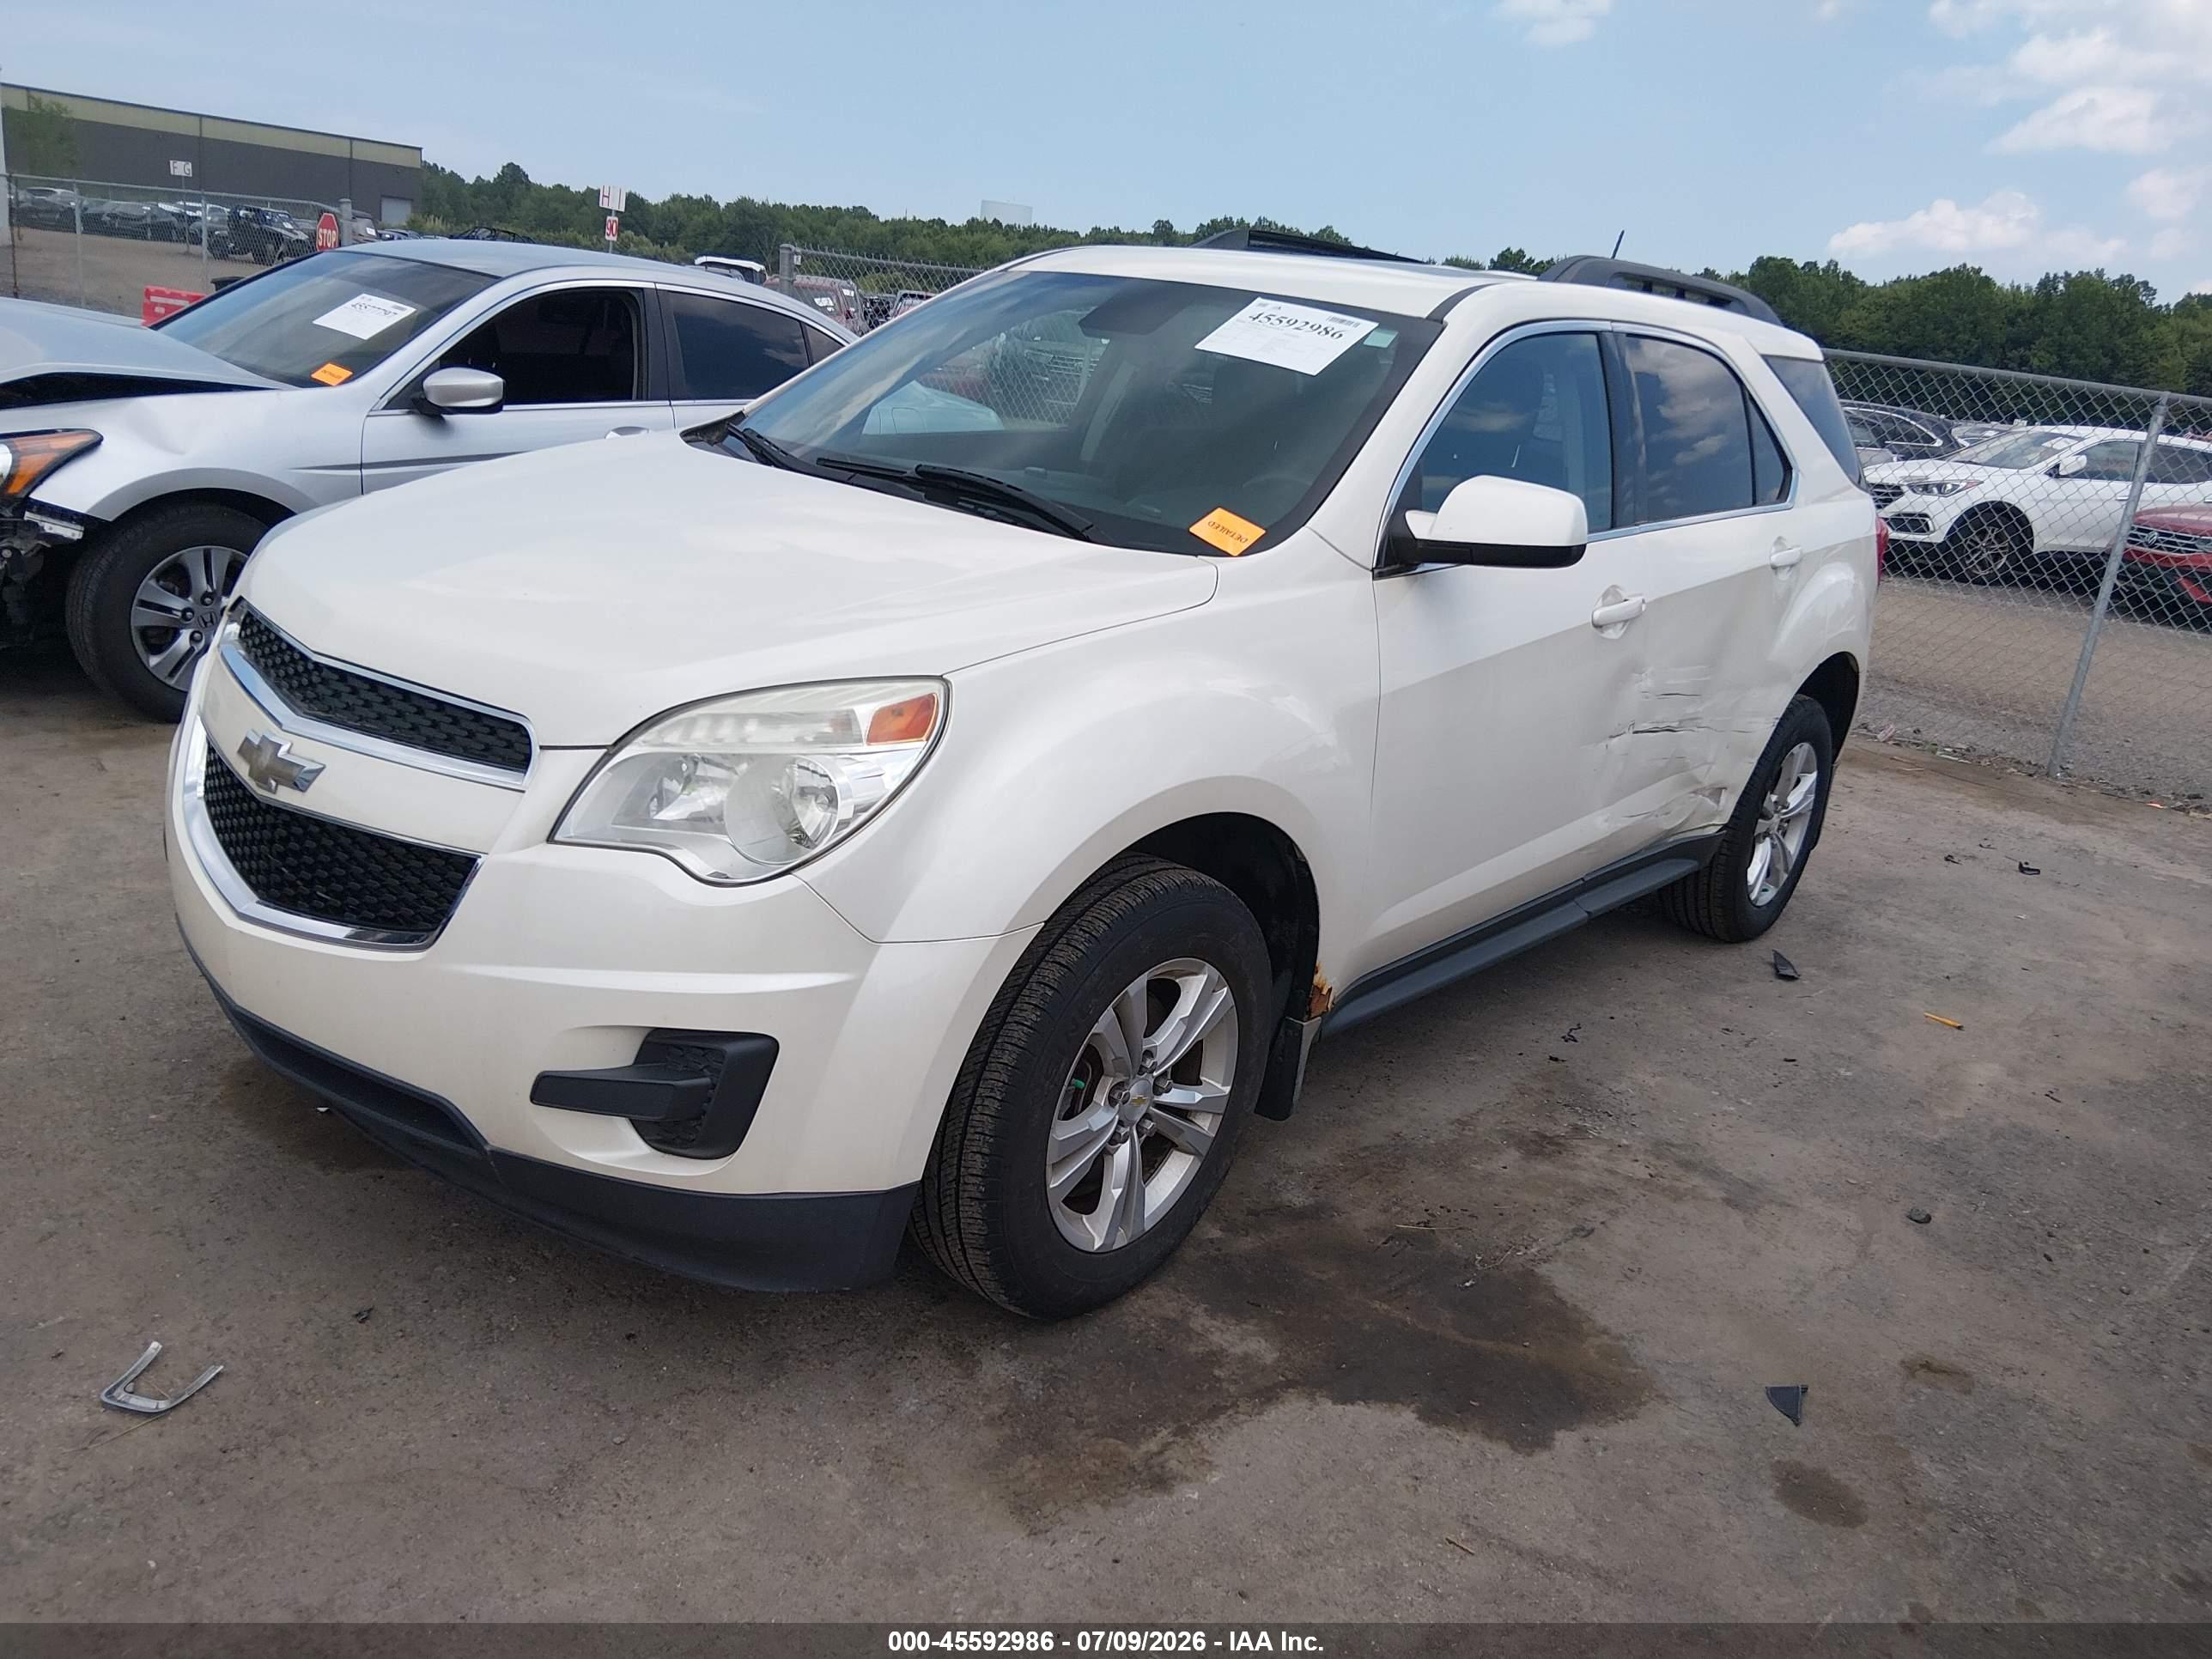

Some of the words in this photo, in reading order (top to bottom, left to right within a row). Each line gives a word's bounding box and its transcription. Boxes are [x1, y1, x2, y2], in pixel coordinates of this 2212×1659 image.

[172, 161, 178, 174] F
[183, 162, 191, 175] G
[602, 185, 611, 207] H
[318, 228, 337, 248] STOP
[606, 219, 617, 237] 90
[1248, 311, 1346, 340] 45592986
[1207, 520, 1249, 544] DETAILED
